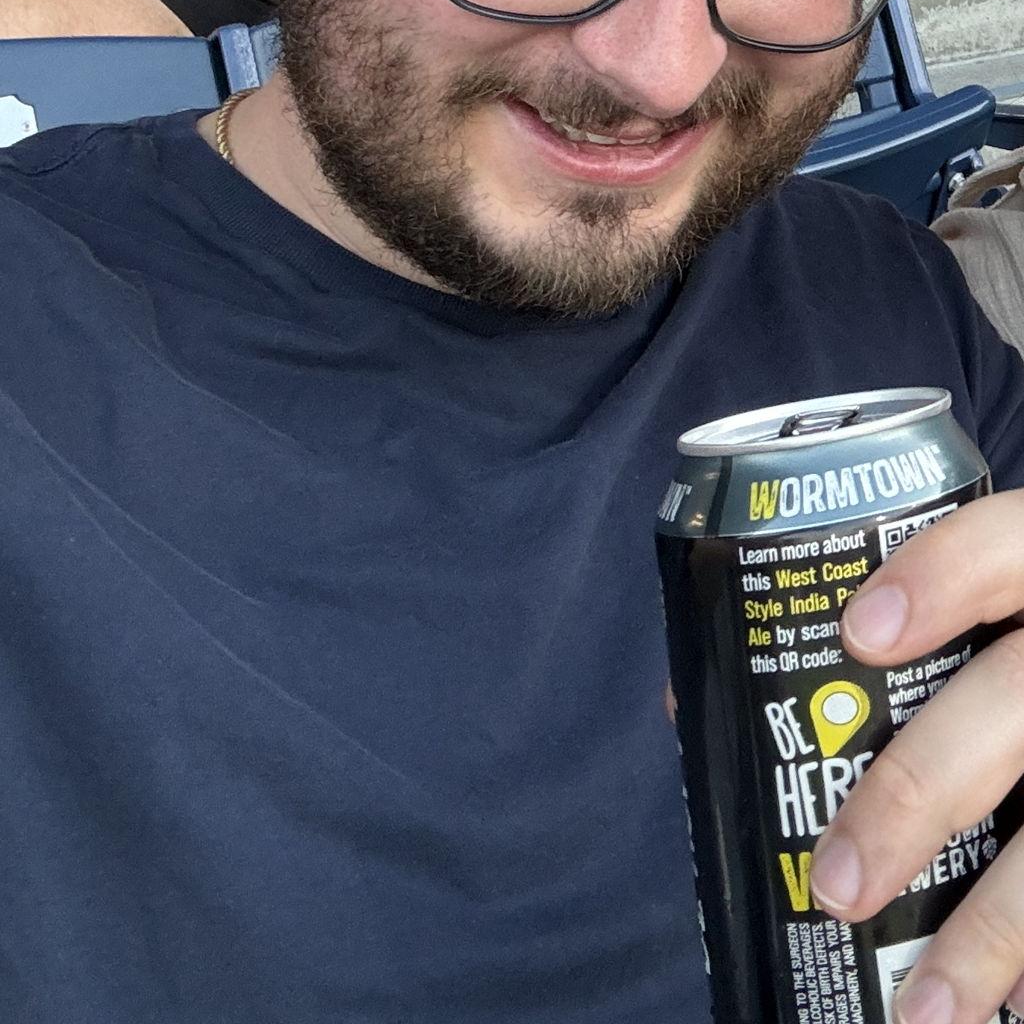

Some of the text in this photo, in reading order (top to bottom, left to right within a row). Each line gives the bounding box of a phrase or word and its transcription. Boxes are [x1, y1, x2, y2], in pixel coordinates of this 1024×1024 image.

[749, 444, 946, 522] WORMTOWN
[738, 529, 866, 565] Learn more about
[741, 556, 869, 592] this West Coast
[744, 598, 784, 623] Style
[789, 592, 830, 616] India
[748, 621, 840, 648] Ale by scan
[751, 646, 843, 674] this QR code:
[886, 644, 971, 689] Post a picture of
[888, 684, 926, 707] where
[764, 696, 815, 761] BE
[898, 838, 980, 897] WERY
[786, 922, 802, 969] SURGEON
[825, 919, 839, 948] YOUR
[829, 950, 845, 991] IMPAIRS
[842, 944, 857, 966] AND
[792, 971, 806, 990] THE
[799, 922, 822, 1024] LCOHOLIC BEVERAGES
[818, 967, 832, 995] BIRTH
[796, 992, 807, 1007] TO
[821, 996, 834, 1009] OF
